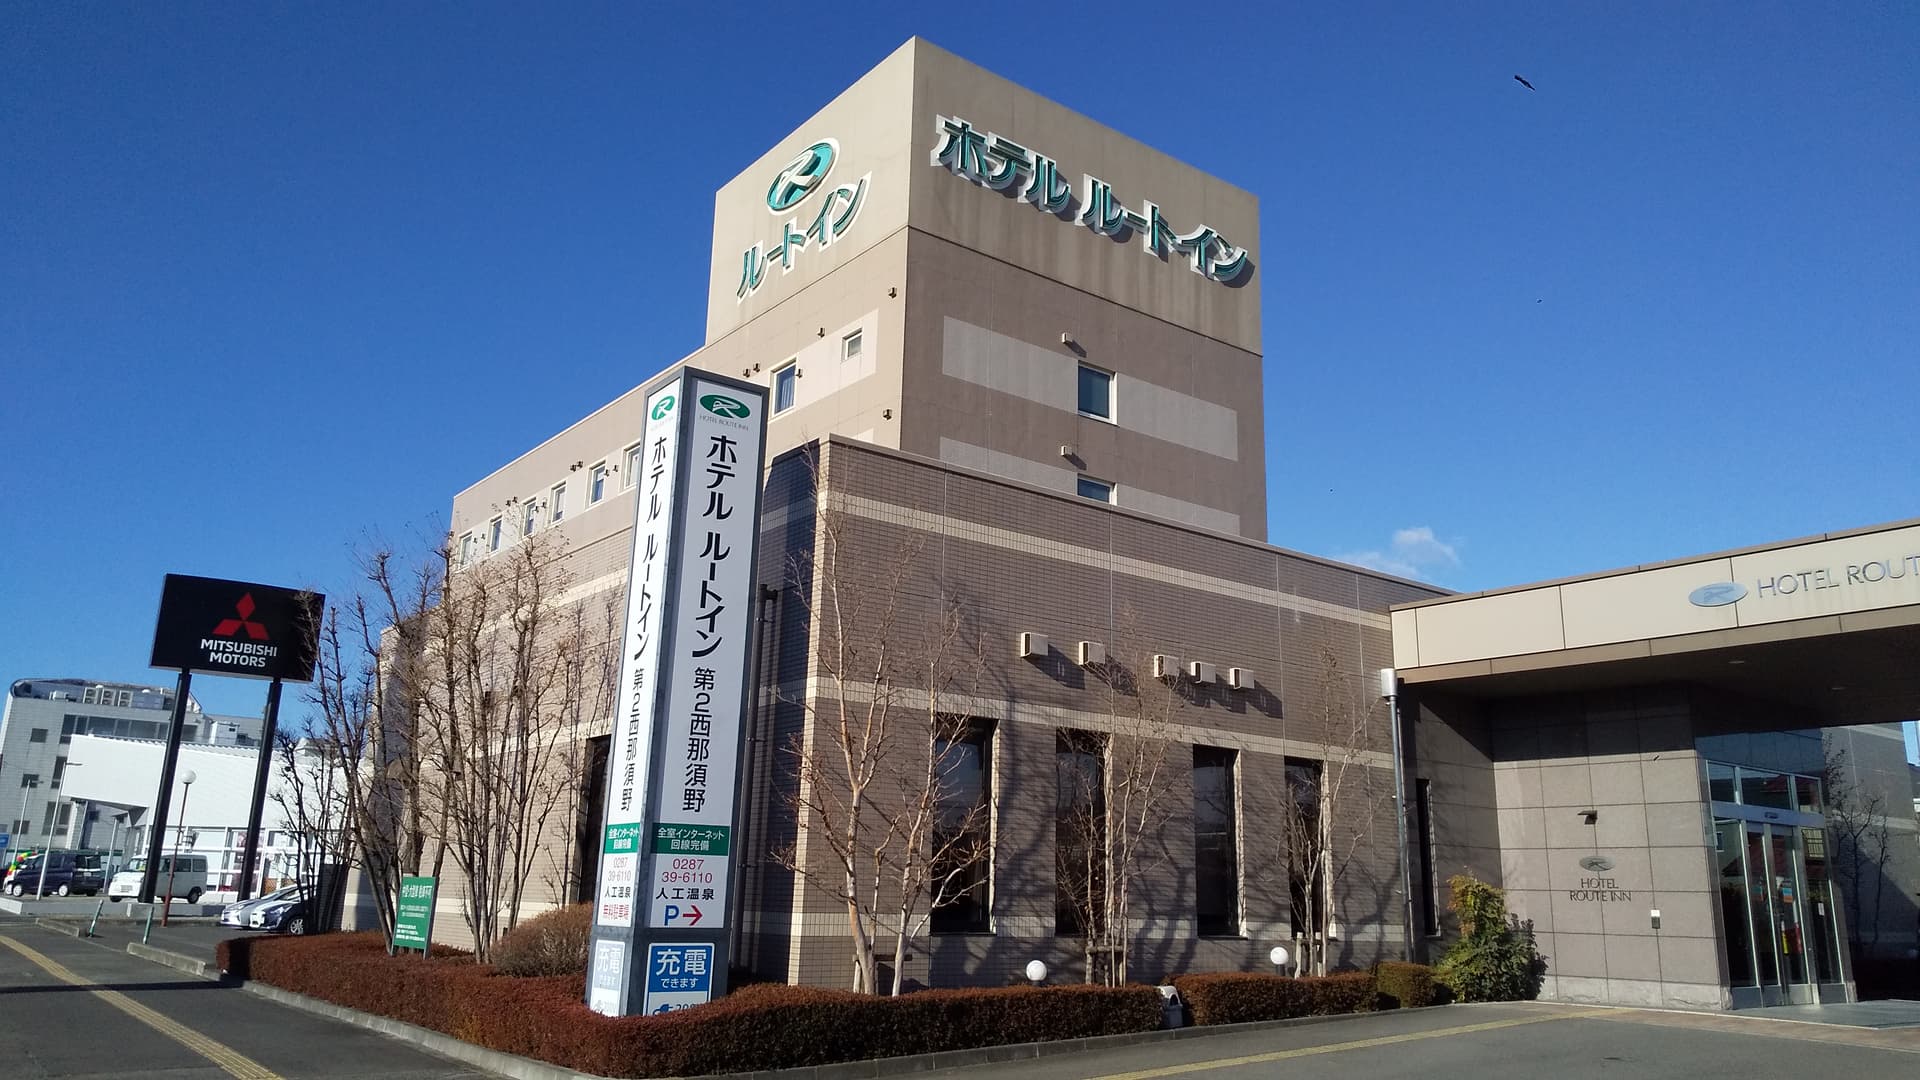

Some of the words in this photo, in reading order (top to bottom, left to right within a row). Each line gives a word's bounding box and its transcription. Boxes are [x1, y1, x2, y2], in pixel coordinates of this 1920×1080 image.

[931, 114, 1071, 214] ホテル
[1075, 173, 1249, 282] ルートイン
[737, 172, 872, 303] ルートイン
[647, 436, 667, 523] ホテル
[702, 435, 737, 520] ホテル
[1757, 569, 1840, 598] HOTEL
[634, 533, 659, 660] ルートイン
[692, 531, 731, 658] ルートイン
[200, 638, 278, 657] MITSUBISHI
[209, 651, 266, 667] MOTORS
[682, 667, 716, 812] 第2西那須野
[657, 827, 724, 840] 全室インターネット
[670, 839, 710, 851] 回線完備
[673, 858, 704, 870] 0287
[661, 871, 713, 883] 39-6110
[1581, 878, 1619, 889] HOTEL
[656, 887, 714, 900] 人工温泉
[1569, 890, 1608, 902] ROUTE
[1610, 890, 1632, 902] INN
[655, 948, 707, 976] 充電
[661, 978, 698, 989] できます
